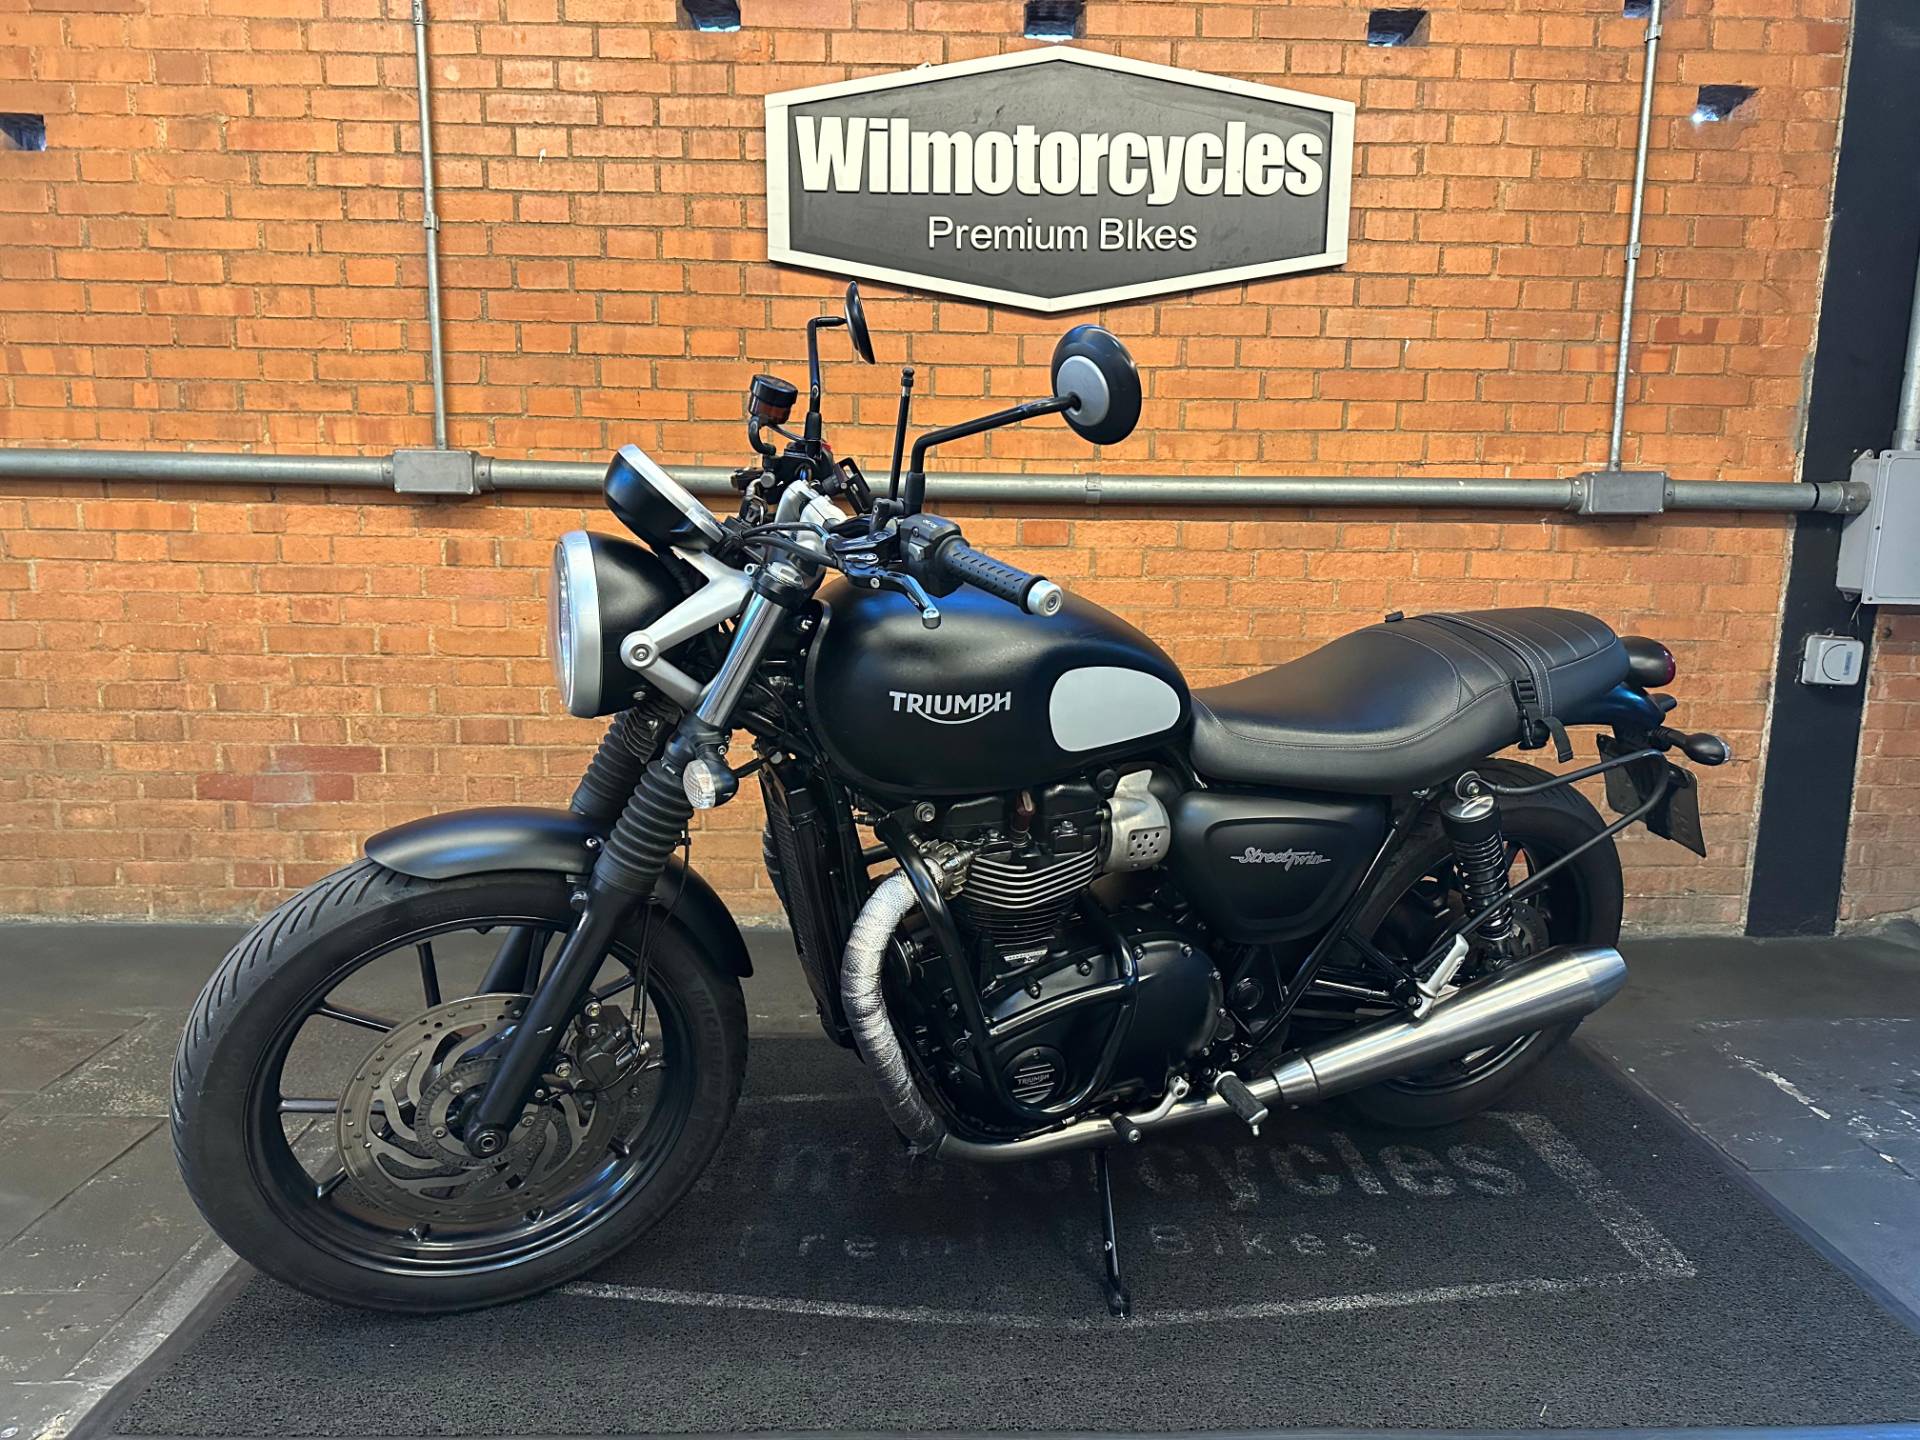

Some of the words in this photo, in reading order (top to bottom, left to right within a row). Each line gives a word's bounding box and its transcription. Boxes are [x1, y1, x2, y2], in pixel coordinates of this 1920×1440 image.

[795, 115, 1324, 205] Wilmotorcycles
[928, 215, 1088, 250] Premium
[889, 690, 1012, 725] TRIUMPH
[1017, 1073, 1050, 1086] TRIUMPH
